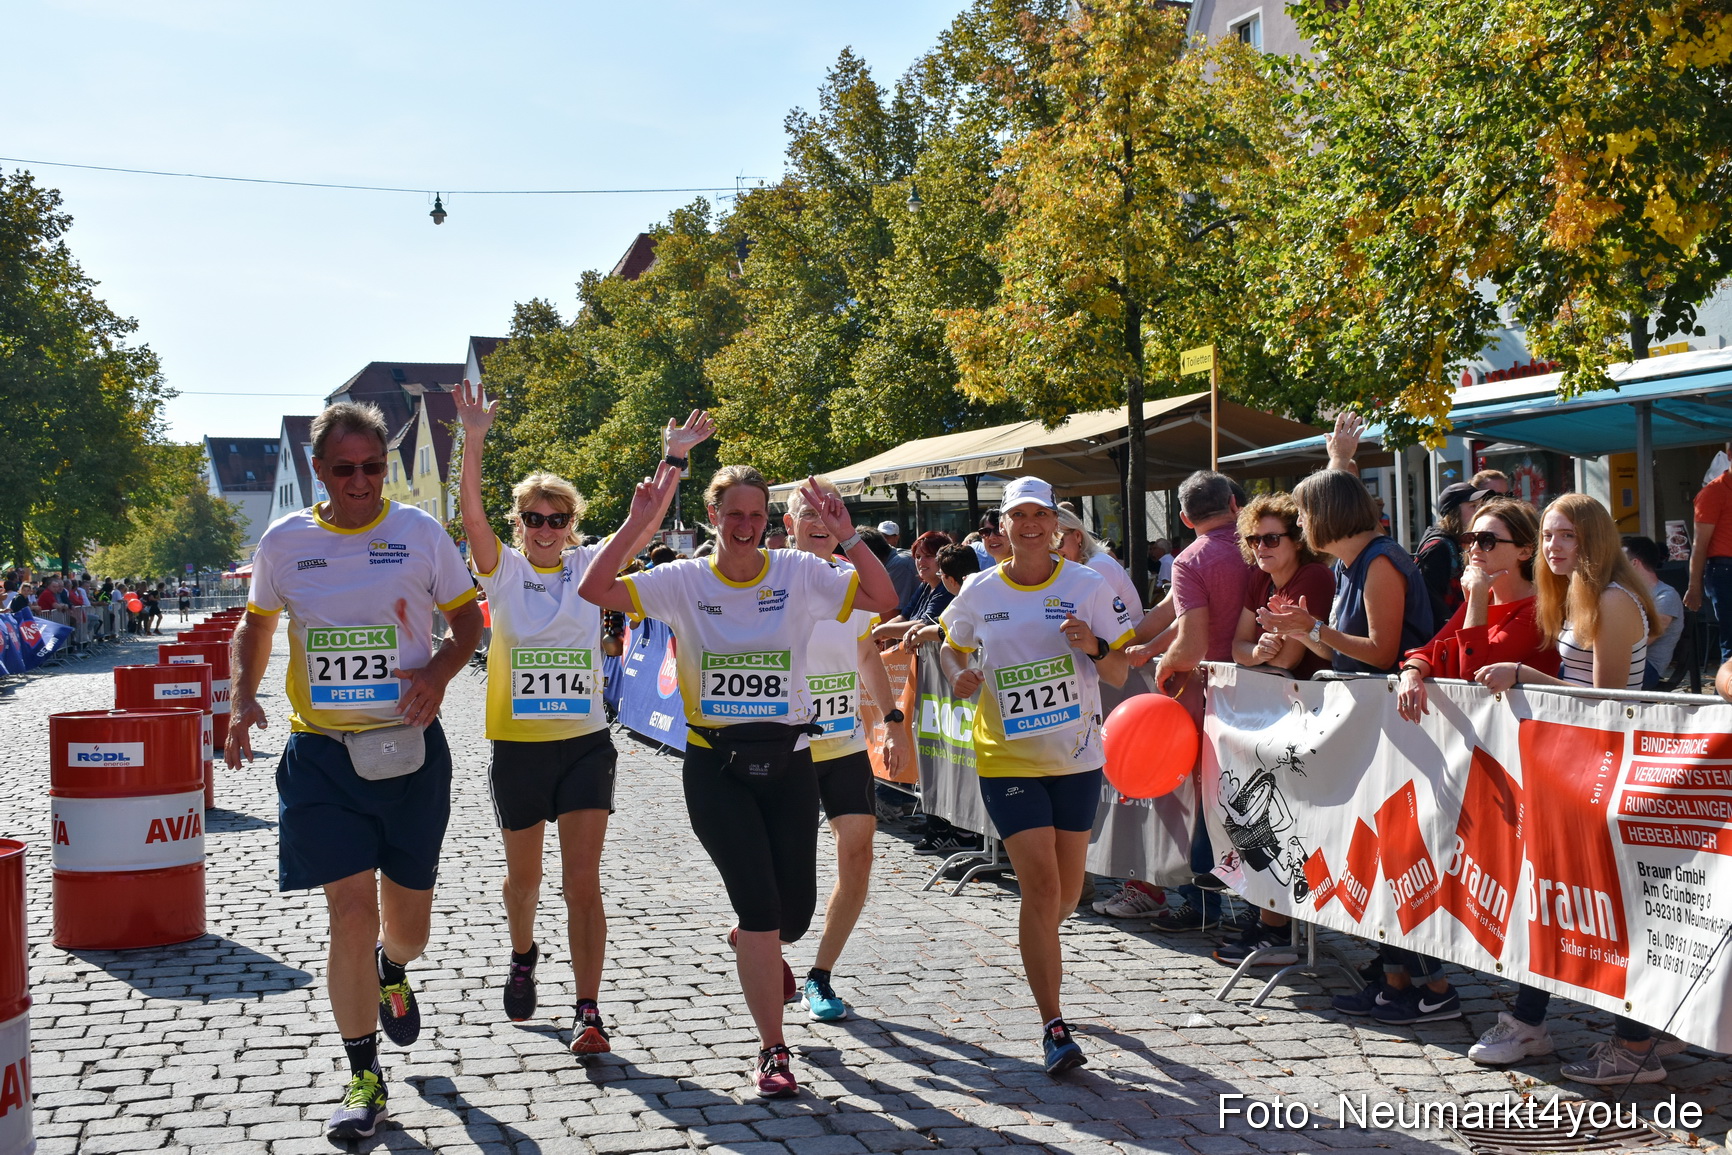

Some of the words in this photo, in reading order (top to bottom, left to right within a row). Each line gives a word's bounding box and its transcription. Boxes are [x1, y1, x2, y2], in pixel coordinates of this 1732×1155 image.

[1187, 355, 1211, 367] Toiletten
[1485, 358, 1564, 383] vodafon
[312, 628, 391, 649] BOCK
[316, 655, 388, 680] 2123
[517, 651, 587, 667] BOCK
[708, 652, 784, 669] BOCK
[521, 673, 584, 694] 2114
[807, 675, 851, 691] OCK
[1001, 658, 1070, 687] BOCK
[331, 688, 375, 699] PETER
[711, 673, 781, 698] 2098
[1008, 681, 1070, 714] 2121
[539, 702, 567, 711] LISA
[712, 704, 777, 715] SUSANNE
[813, 695, 849, 718] 113
[920, 699, 977, 742] BOC
[1017, 711, 1070, 730] CLAUDIA
[1641, 736, 1709, 754] BINDESTRICKE
[1591, 783, 1603, 804] Seit
[1597, 751, 1614, 779] 1929
[1627, 826, 1717, 849] HEBEBÄNDER
[1340, 859, 1367, 906] Braun
[1386, 857, 1434, 911] Braun
[1445, 834, 1508, 923] Braun
[1637, 861, 1672, 880] Braun
[1675, 866, 1706, 886] GmbH
[1311, 876, 1332, 901] Braun
[1411, 896, 1424, 910] Sicher
[1429, 883, 1441, 897] sicher
[1526, 859, 1618, 942] Braun
[1643, 881, 1660, 897] Am
[1662, 883, 1705, 911] Grünberg
[1706, 893, 1711, 909] 8
[1466, 897, 1480, 919] Sicher
[1480, 914, 1488, 926] ist
[1488, 922, 1506, 943] sicher
[1645, 900, 1682, 923] D-92318
[1561, 937, 1586, 958] Sicher
[1589, 944, 1602, 961] ist
[1603, 949, 1629, 968] sicher
[1647, 929, 1663, 947] Tel.
[1665, 933, 1687, 955] 09181
[1647, 949, 1662, 967] Fax
[1664, 954, 1683, 975] 09181
